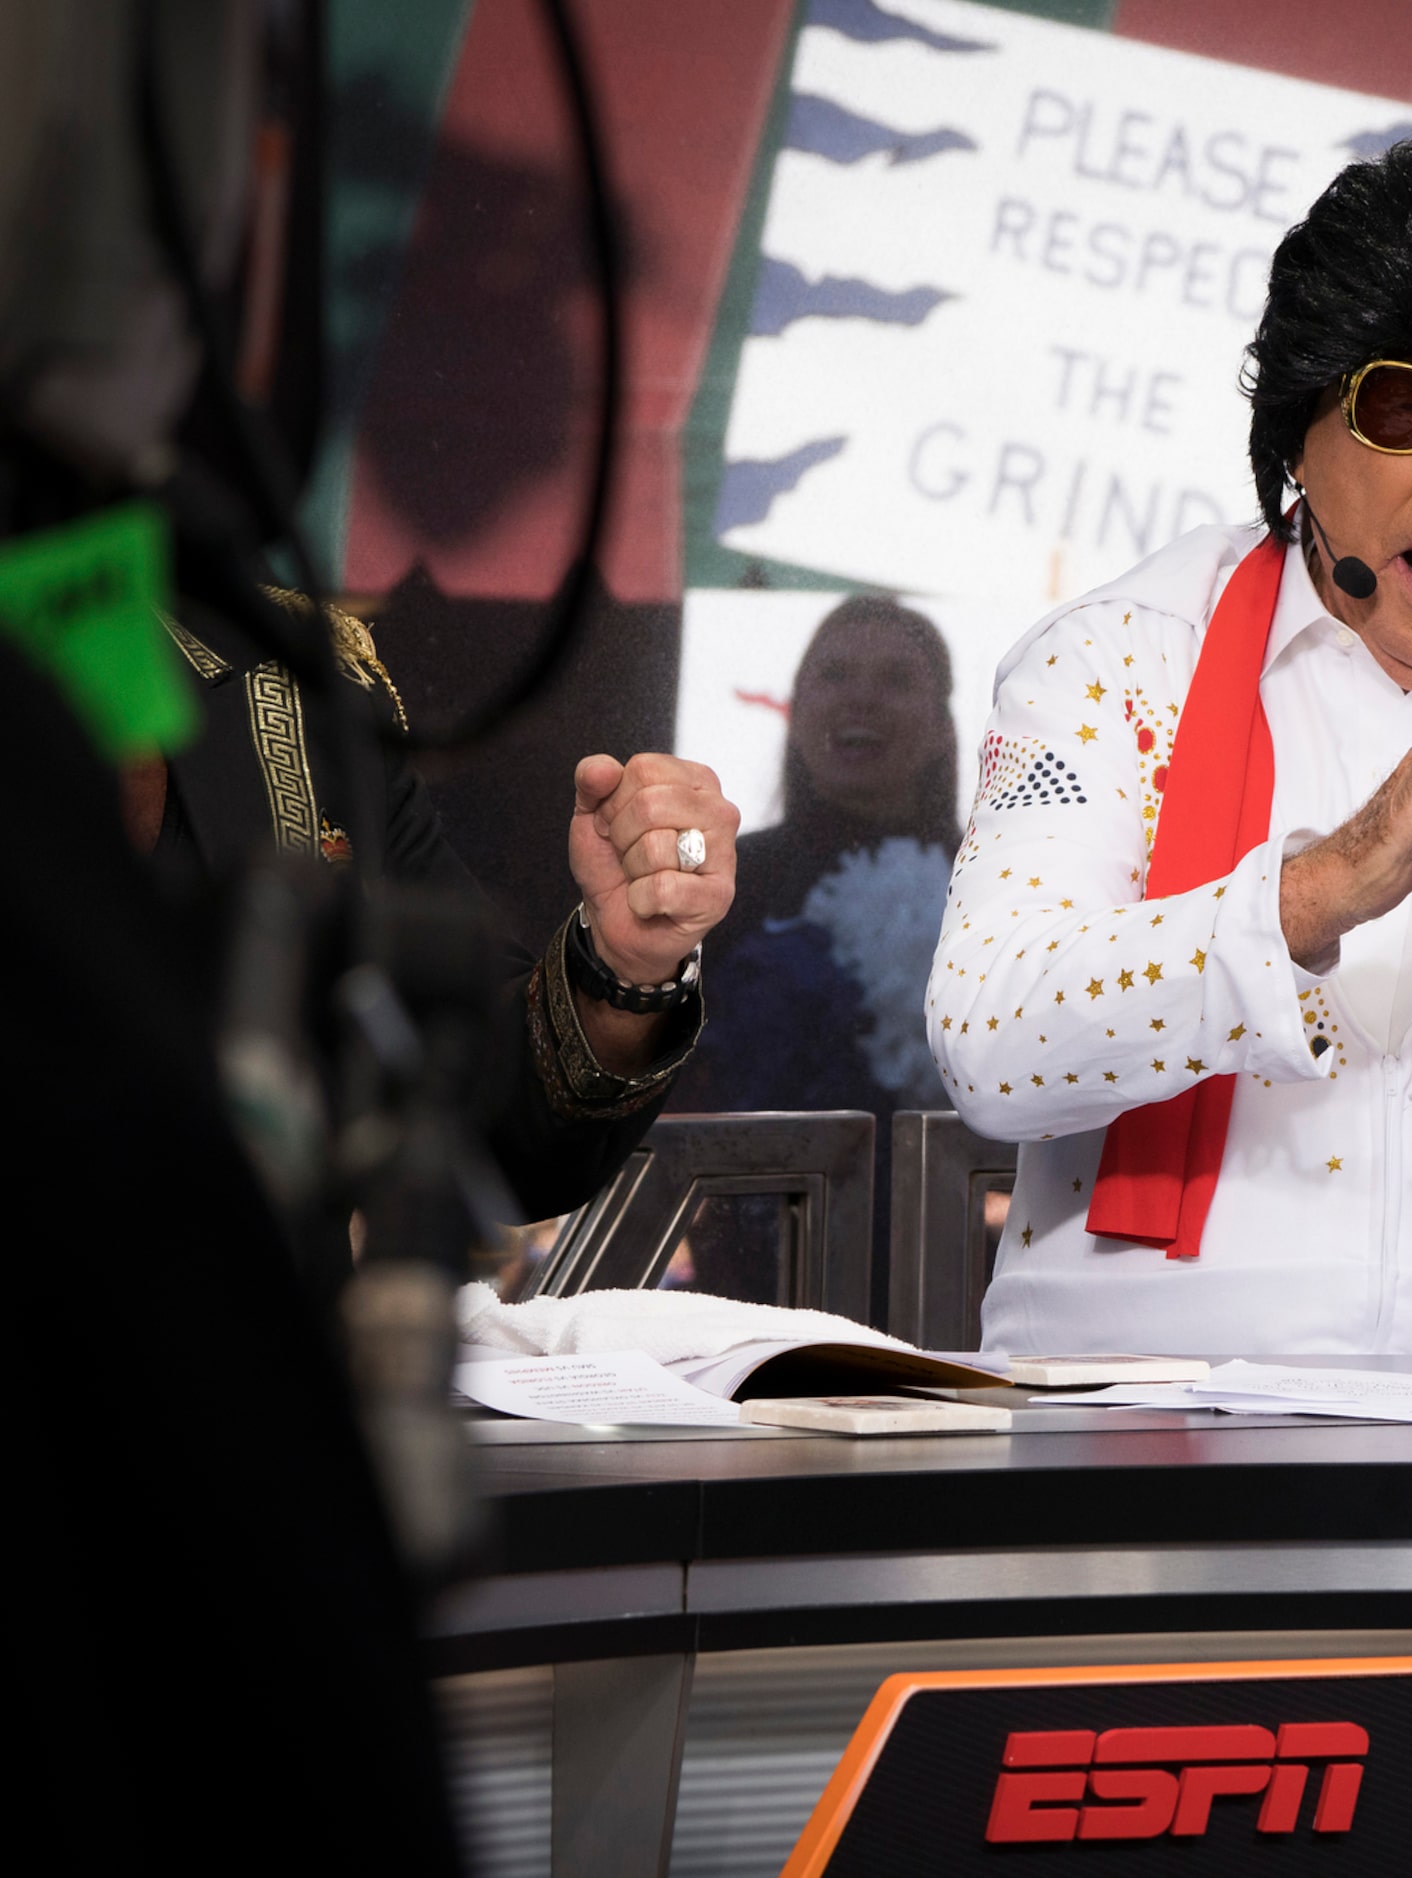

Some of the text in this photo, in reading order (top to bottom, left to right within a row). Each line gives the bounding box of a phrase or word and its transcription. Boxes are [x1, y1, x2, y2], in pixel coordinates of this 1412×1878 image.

[1016, 86, 1301, 226] PLEASE
[988, 197, 1273, 323] RESPEC
[1048, 343, 1185, 436] THE
[983, 1720, 1370, 1843] ESPN
